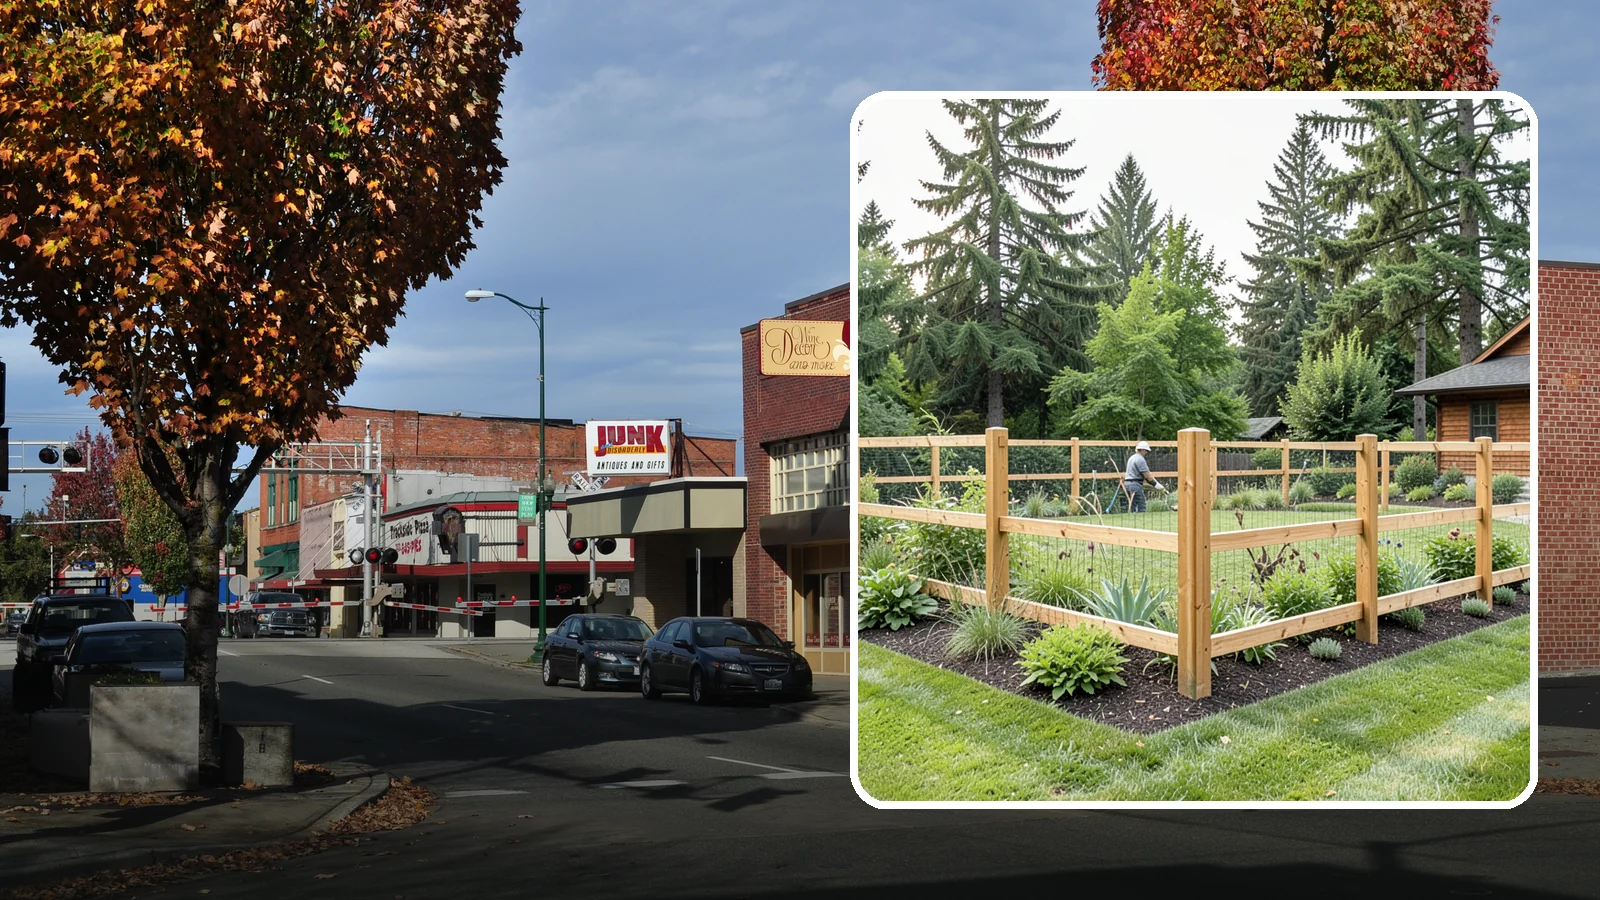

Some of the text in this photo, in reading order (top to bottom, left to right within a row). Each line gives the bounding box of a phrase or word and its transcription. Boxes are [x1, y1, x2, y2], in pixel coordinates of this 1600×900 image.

[765, 328, 830, 365] Decor
[596, 425, 665, 457] JUNK
[607, 446, 646, 454] DISORDERLY
[597, 460, 665, 470] ANTIQUES AND GIFTS
[573, 473, 588, 492] RAIL
[352, 498, 365, 511] CRO
[390, 519, 429, 540] Trackside Pizza
